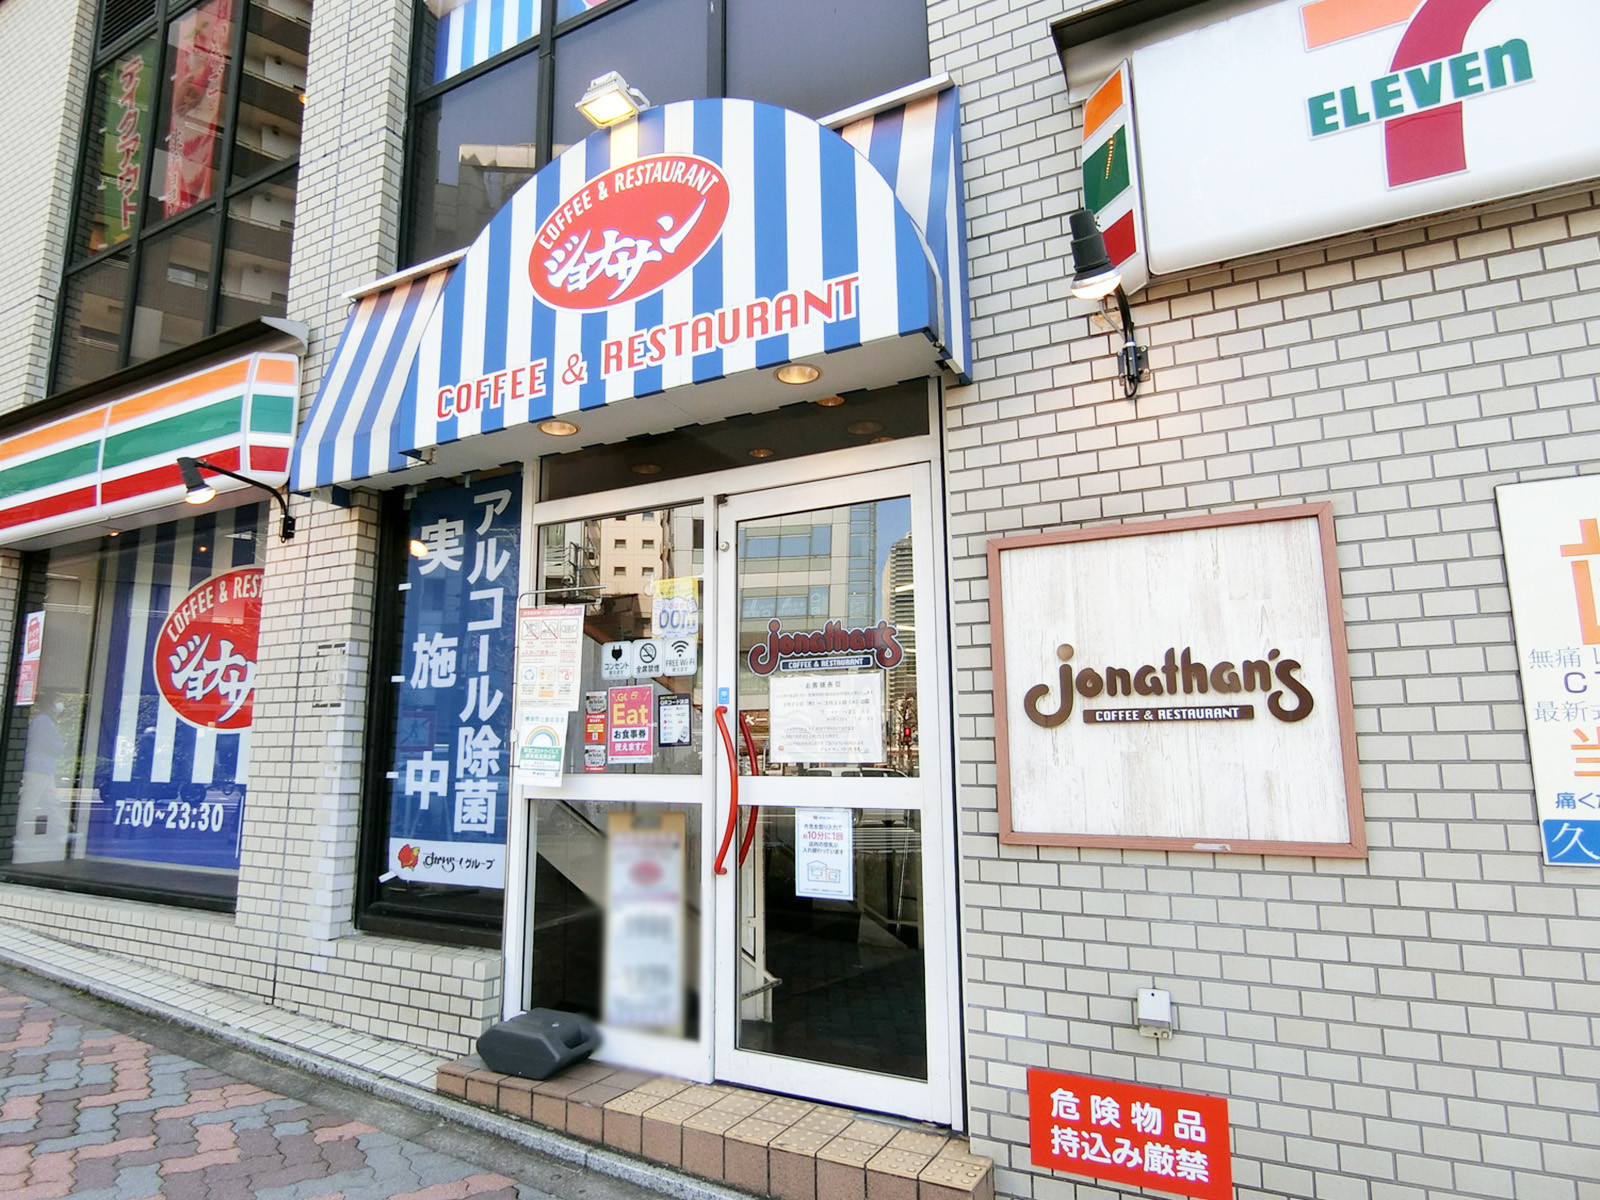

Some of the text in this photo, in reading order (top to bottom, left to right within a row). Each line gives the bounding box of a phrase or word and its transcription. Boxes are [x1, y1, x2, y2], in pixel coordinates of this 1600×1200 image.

[117, 54, 144, 230] テイクアウト
[538, 160, 720, 250] COFFEE & RESTAURANT
[543, 196, 707, 301] ジョナサン
[436, 276, 860, 418] COFFEE & RESTAURANT
[166, 585, 215, 643] COFFEE
[219, 580, 229, 603] &
[405, 518, 466, 811] 実施中
[453, 487, 512, 835] アルコール除菌
[604, 662, 629, 670] コンセント
[636, 664, 660, 673] 全席禁煙
[665, 659, 679, 667] FREE
[749, 618, 903, 675] jonathan's
[788, 658, 864, 669] COFFEE & RESTAURANT
[1528, 648, 1581, 670] 無痛
[612, 702, 649, 726] Eat
[1023, 643, 1315, 729] jonathan's
[1095, 707, 1240, 722] COFFEE & RESTAURANT
[613, 729, 646, 740] お食事券
[1049, 1087, 1207, 1143] 危険物品
[1050, 1124, 1210, 1184] 持込み厳禁
